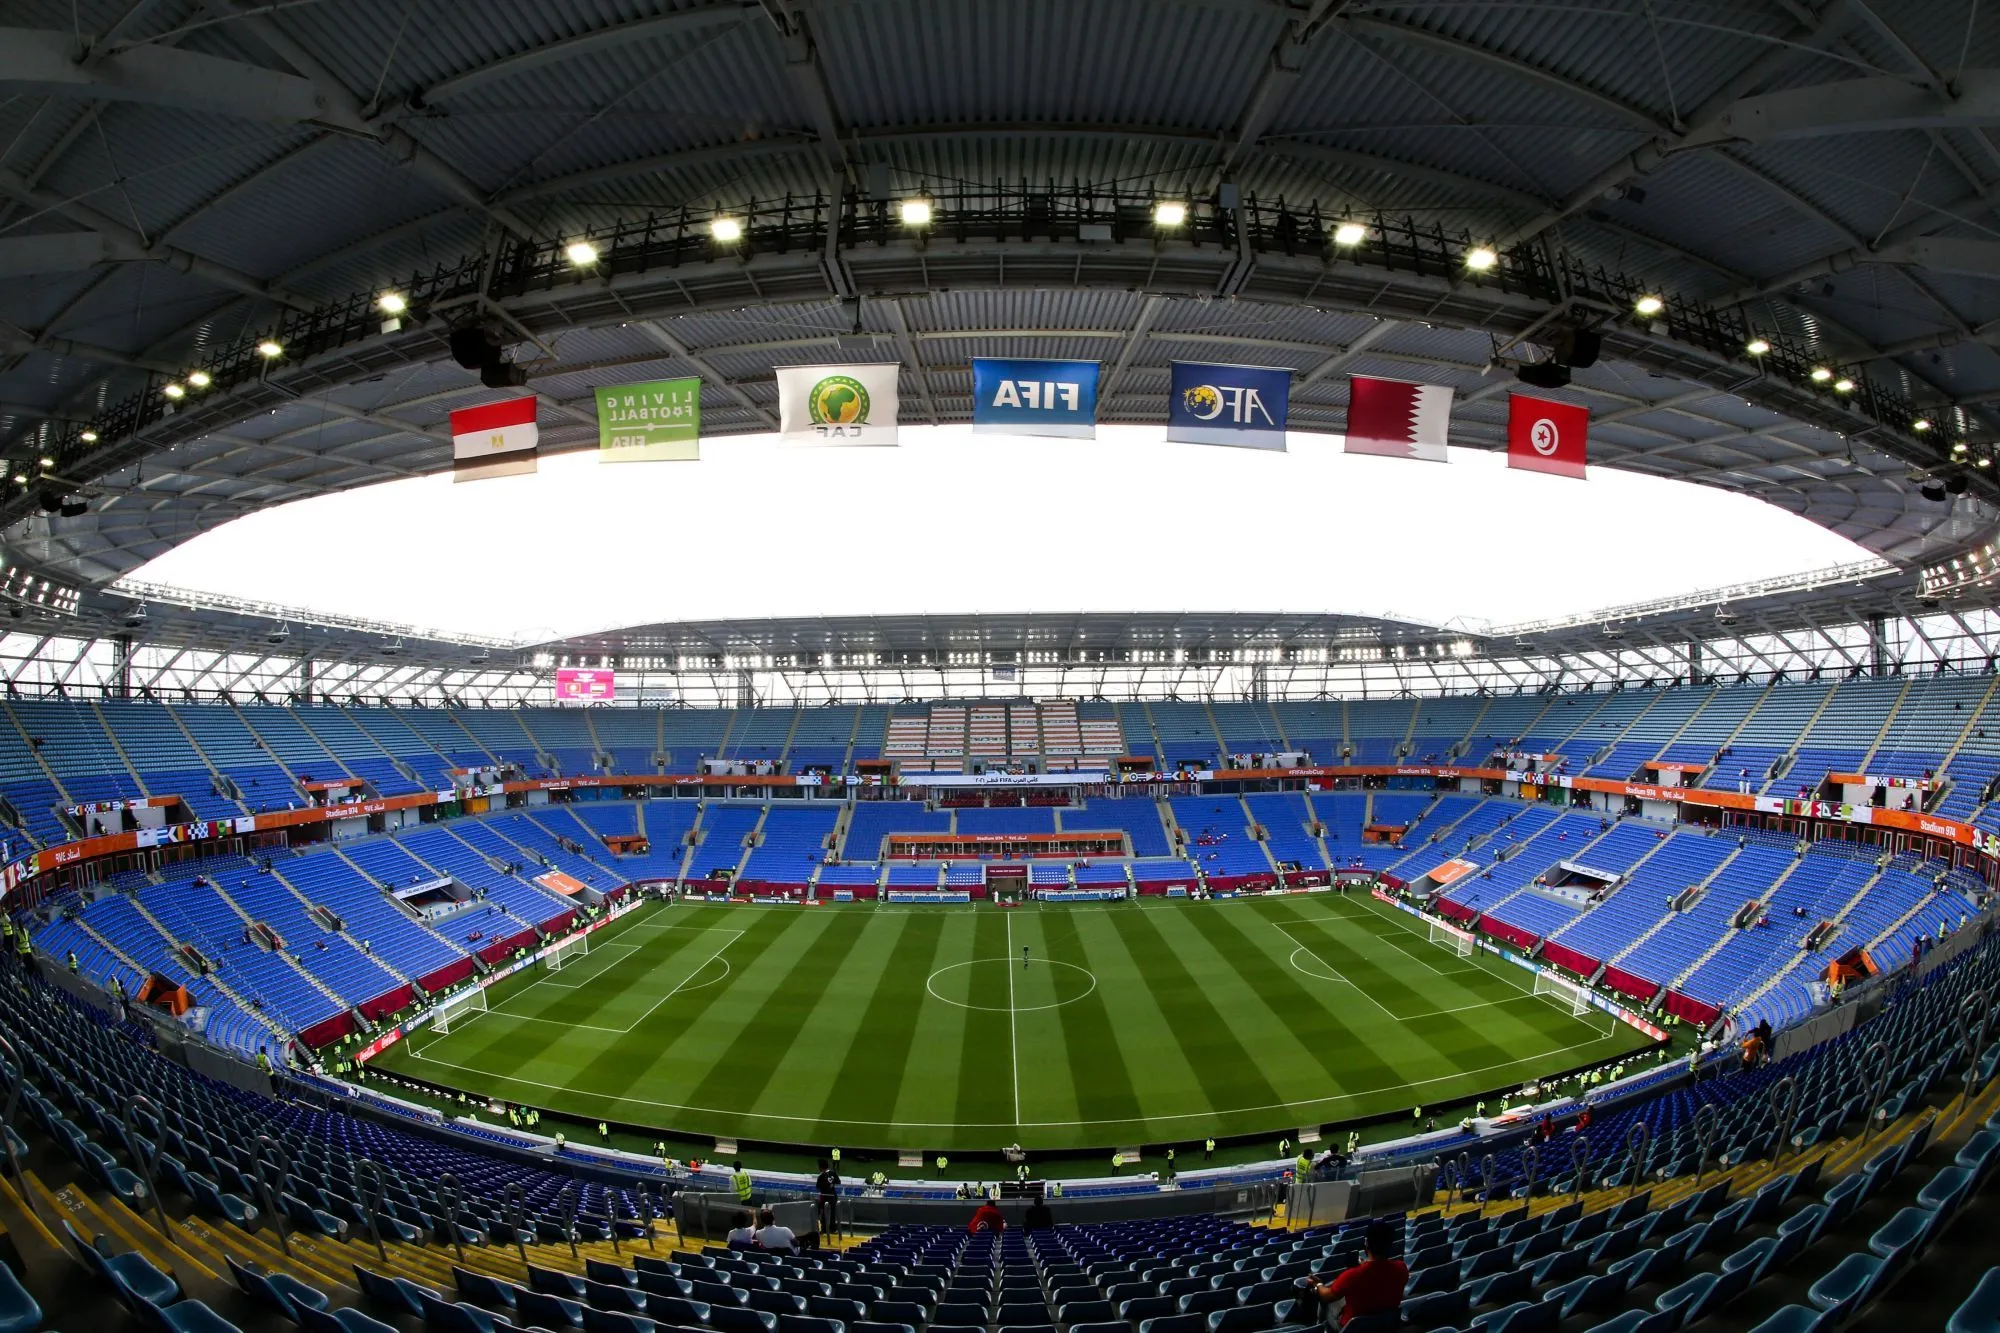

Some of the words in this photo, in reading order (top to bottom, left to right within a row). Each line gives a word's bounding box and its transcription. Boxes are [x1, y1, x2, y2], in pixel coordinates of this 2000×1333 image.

[326, 809, 347, 817] Stadium
[1920, 820, 1945, 834] Stadium
[1946, 826, 1955, 837] 974
